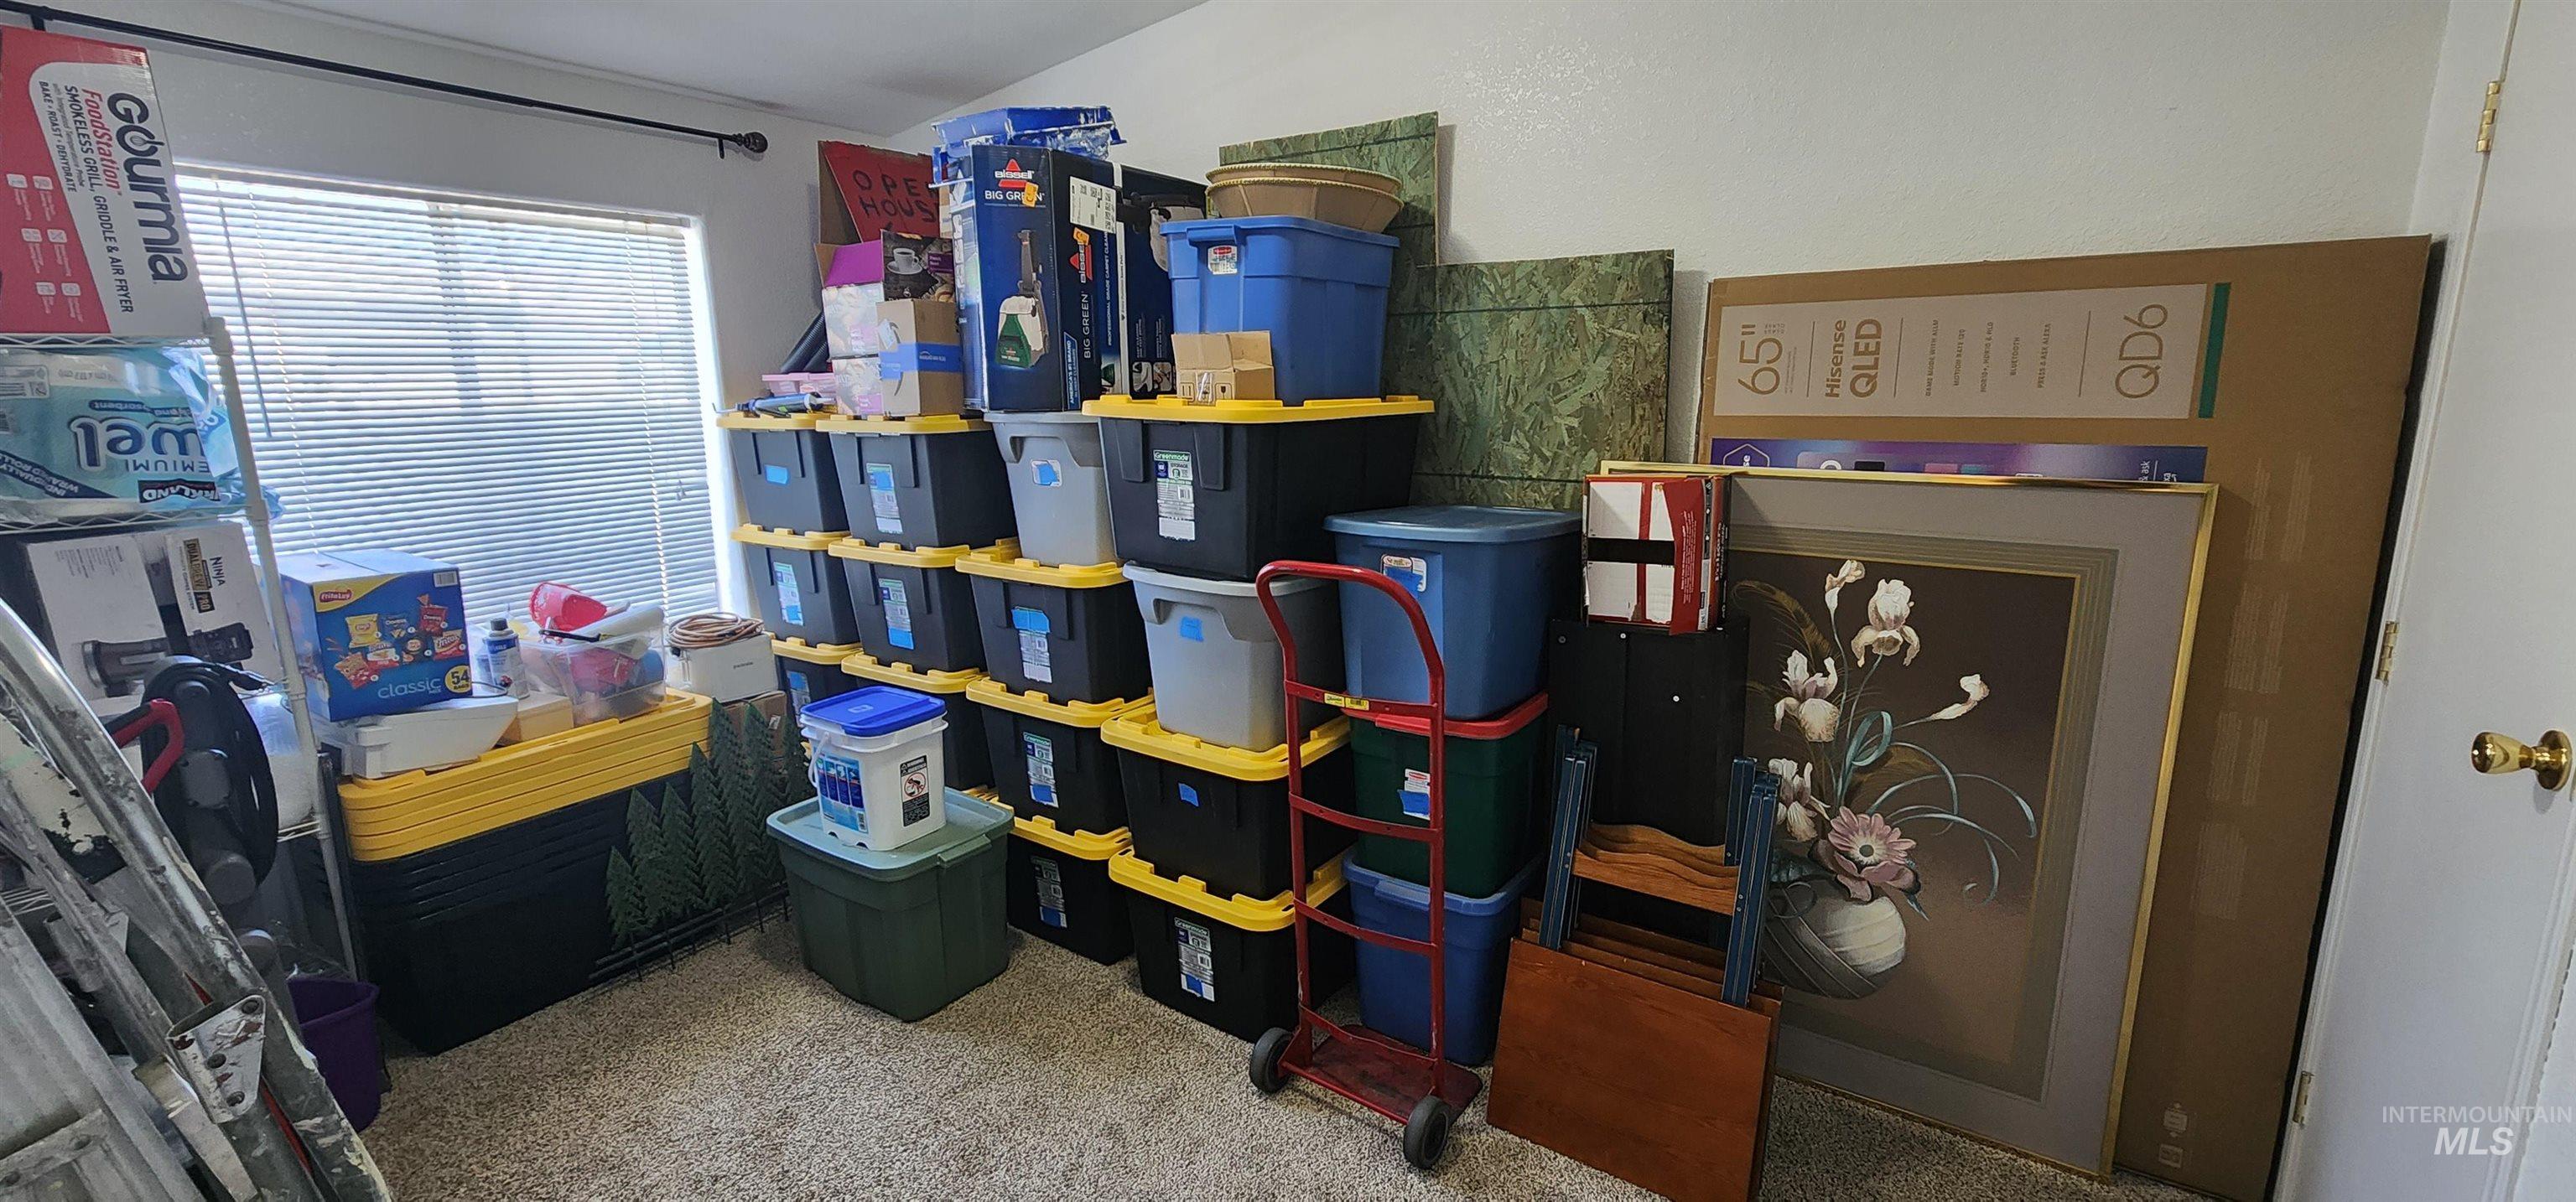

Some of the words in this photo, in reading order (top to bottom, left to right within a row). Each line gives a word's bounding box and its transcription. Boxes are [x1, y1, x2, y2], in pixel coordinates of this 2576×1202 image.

[39, 80, 54, 104] BAKE
[48, 111, 64, 138] ROAST
[65, 85, 94, 154] SMOKELESS
[81, 88, 121, 189] FoodStation
[55, 144, 77, 193] DEHYDRATE
[84, 157, 103, 192] GRILL,
[107, 92, 189, 282] Gourmia
[984, 189, 1004, 199] BIG
[1006, 191, 1043, 201] GREN
[93, 195, 117, 243] GRIDDLE
[859, 195, 938, 223] HOUS
[108, 256, 125, 276] AIR
[114, 278, 134, 313] FRYER
[1082, 293, 1091, 338] GREEN
[1825, 319, 1846, 398] Hisense
[1849, 319, 1883, 398] QLED
[2010, 336, 2020, 376] BLUETOOTH
[2115, 303, 2168, 399] QD6
[1927, 356, 1935, 376] MODE
[1953, 359, 1961, 386] MOTION
[1925, 377, 1934, 396] GAME
[74, 419, 205, 469] wel
[1154, 451, 1189, 461] Greenmade
[133, 459, 211, 473] EMIUM
[2140, 460, 2151, 474] ask
[143, 484, 221, 502] IRKLAND
[209, 556, 226, 587] NINJA
[196, 593, 211, 611] PRO
[377, 676, 441, 699] classic
[451, 670, 470, 685] 54
